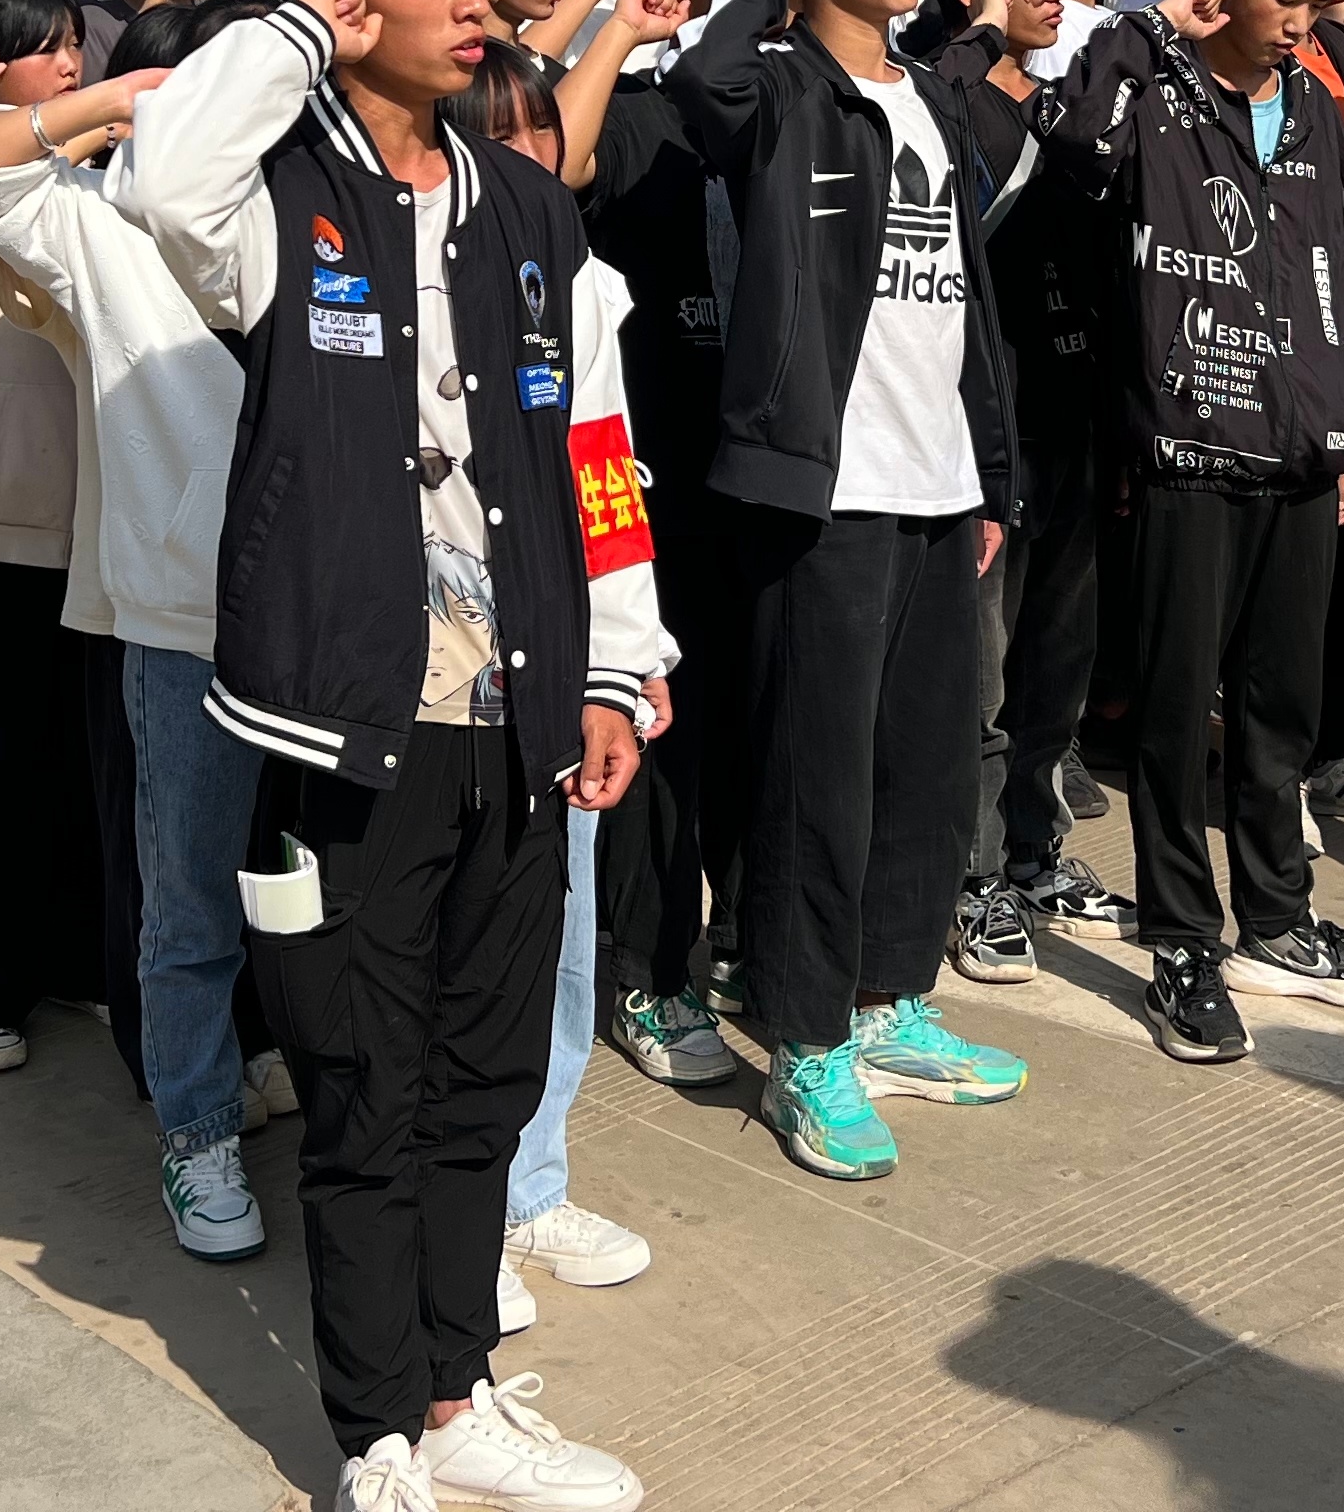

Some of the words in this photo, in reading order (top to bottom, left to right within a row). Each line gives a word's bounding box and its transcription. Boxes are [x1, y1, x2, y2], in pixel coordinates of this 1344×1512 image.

[330, 312, 367, 328] DOUBT
[1195, 344, 1207, 355] TO
[1194, 360, 1206, 371] TO
[1208, 362, 1229, 376] THE
[1231, 365, 1258, 381] WEST
[1193, 375, 1205, 386] TO
[1208, 377, 1228, 390] THE
[1230, 381, 1254, 395] EAST
[1192, 390, 1205, 401] TO
[1207, 392, 1227, 406] THE
[1229, 396, 1263, 413] NORTH
[578, 454, 649, 538] 生会
